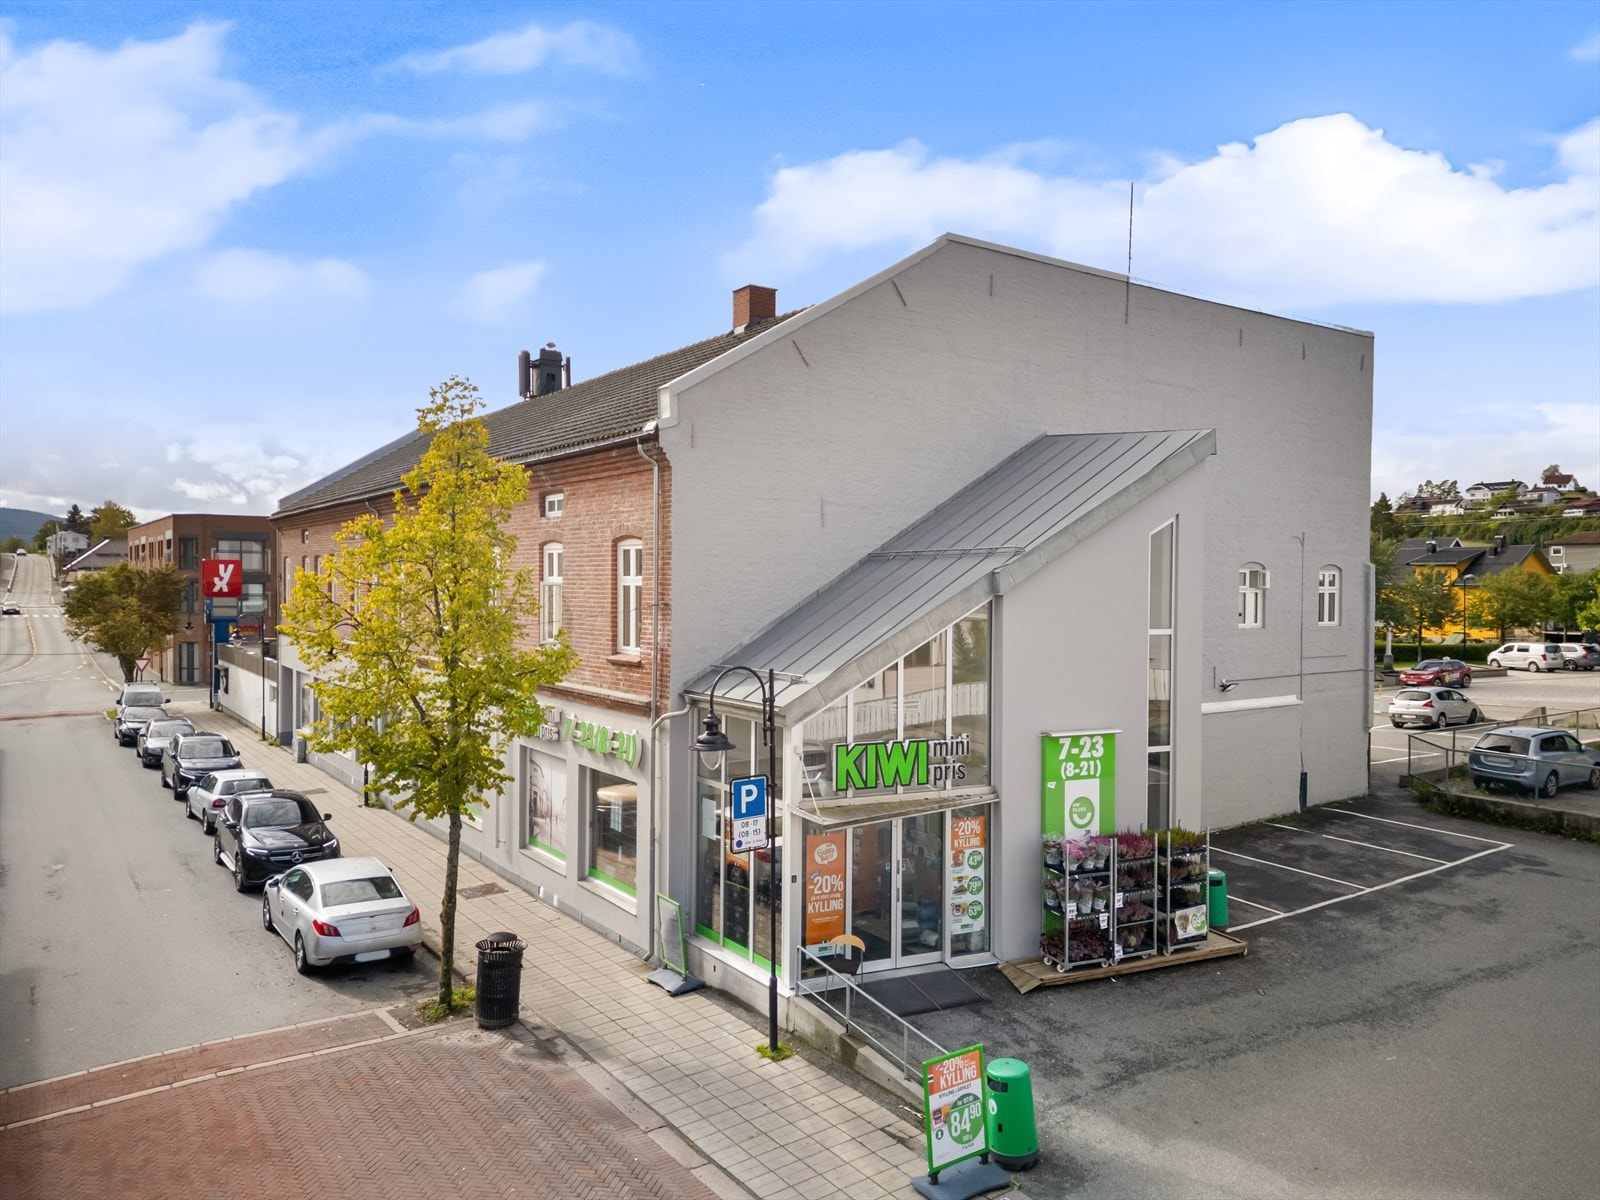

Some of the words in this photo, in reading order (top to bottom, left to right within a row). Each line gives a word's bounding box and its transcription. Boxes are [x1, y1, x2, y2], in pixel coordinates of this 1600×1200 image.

[933, 734, 970, 758] mini
[1059, 735, 1104, 760] 7-23
[836, 740, 928, 791] KIWI
[933, 760, 966, 786] pris
[1061, 759, 1101, 780] (8-21)
[741, 784, 758, 814] P
[954, 820, 981, 835] -20%
[954, 837, 980, 848] KYLLING
[808, 874, 844, 895] -20%
[808, 898, 844, 914] KYLLING
[940, 1056, 964, 1074] -20%
[940, 1064, 977, 1090] KYLLING
